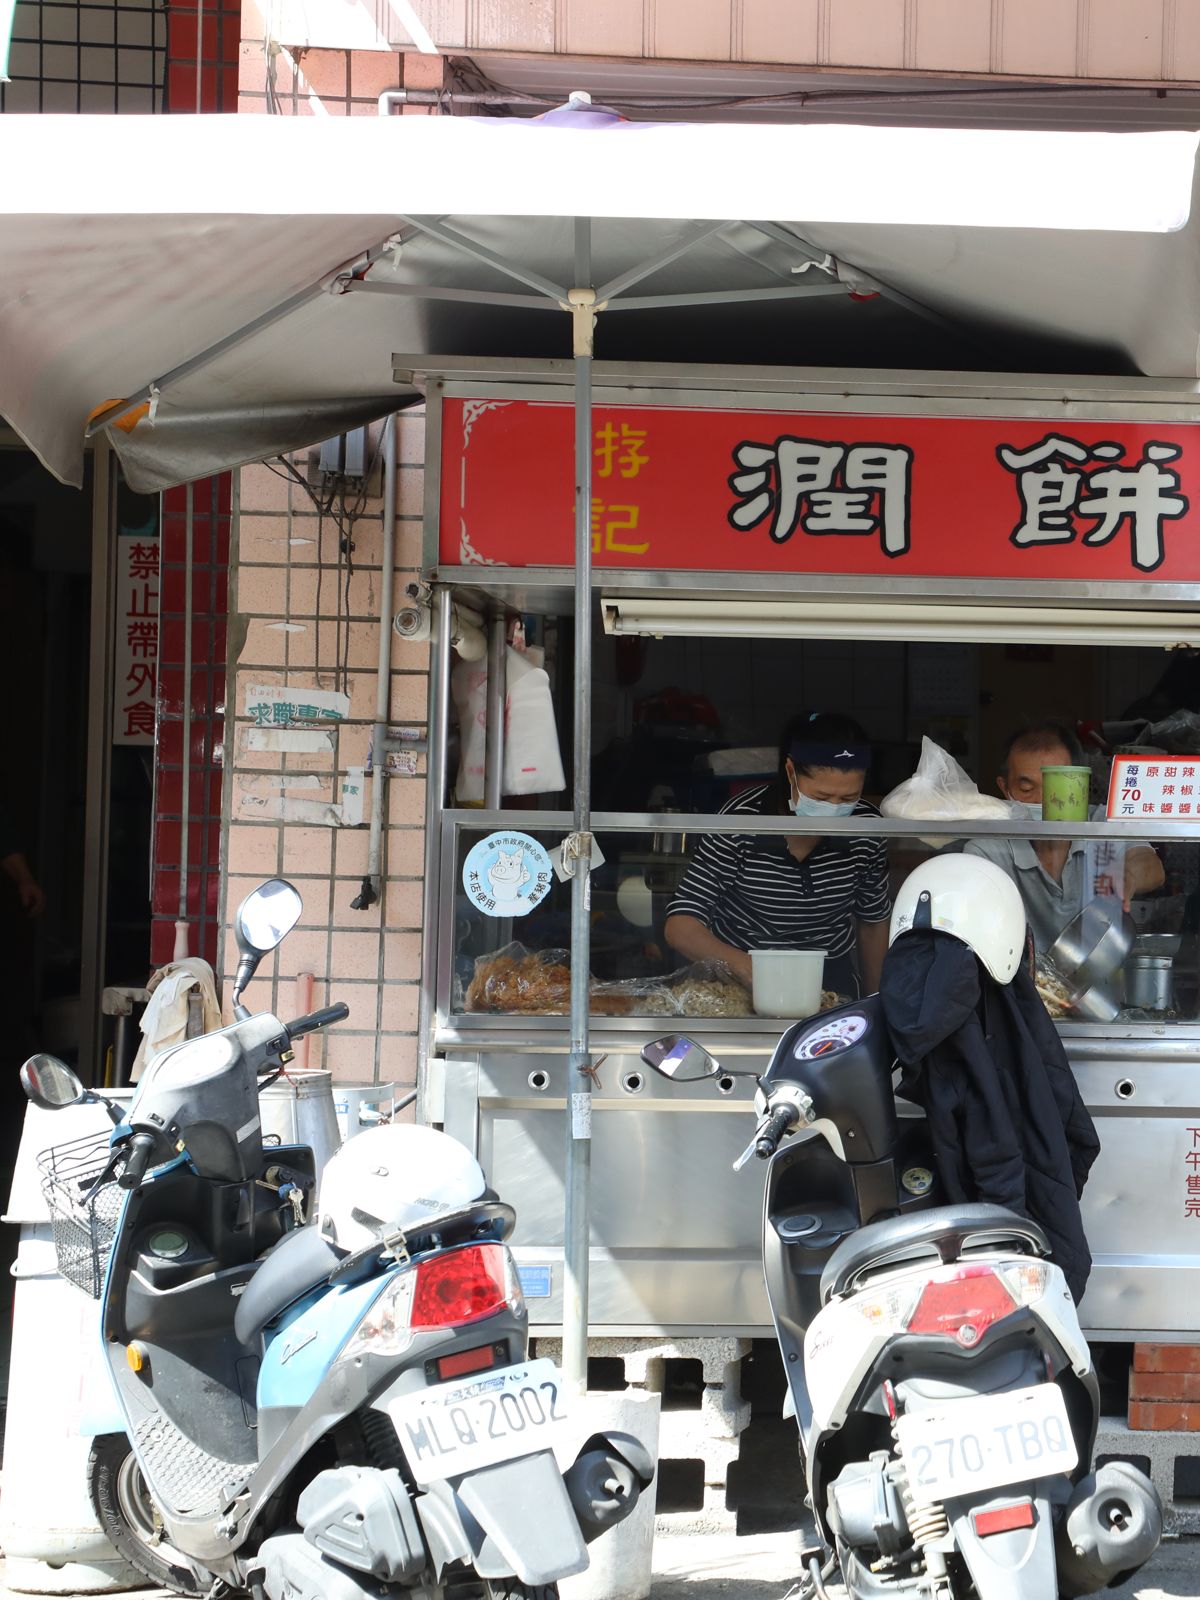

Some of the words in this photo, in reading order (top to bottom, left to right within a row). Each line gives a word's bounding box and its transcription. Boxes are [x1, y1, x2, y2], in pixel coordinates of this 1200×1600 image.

[728, 434, 1190, 573] 潤餅
[123, 543, 160, 737] 禁止帶外食
